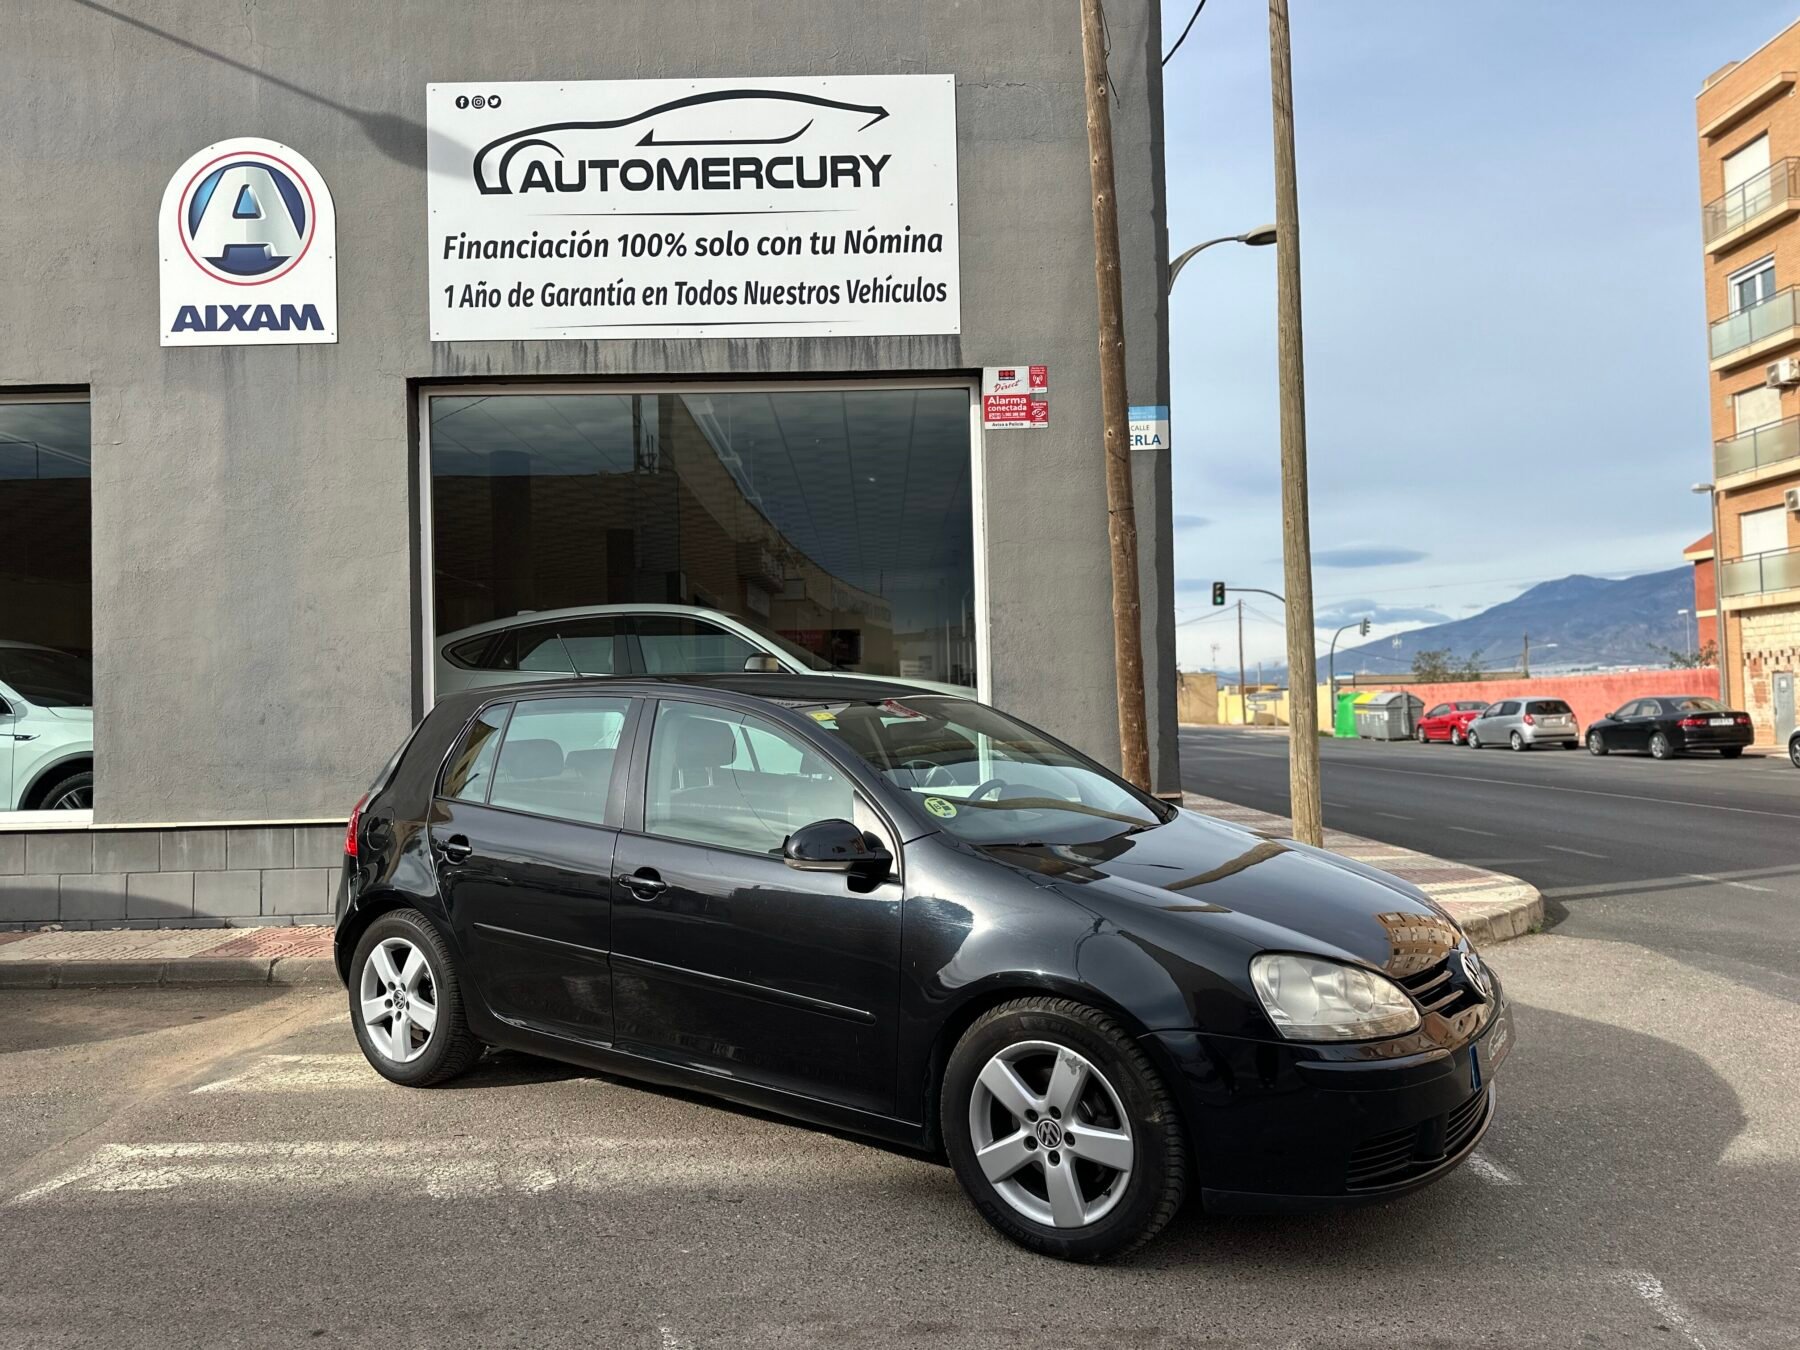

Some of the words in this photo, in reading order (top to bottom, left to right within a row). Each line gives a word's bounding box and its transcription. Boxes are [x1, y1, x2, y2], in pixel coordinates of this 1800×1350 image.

[520, 155, 892, 194] AUTOMERCURY
[443, 229, 609, 260] Financiación
[617, 232, 687, 258] 100%
[694, 229, 750, 257] solo
[756, 235, 802, 256] con
[809, 231, 836, 256] tu
[843, 225, 943, 255] Nómina
[444, 284, 454, 308] 1
[458, 280, 502, 308] Año
[507, 281, 535, 308] de
[540, 277, 636, 308] Garantía
[642, 286, 668, 306] en
[674, 279, 738, 306] Todos
[743, 280, 840, 306] Nuestros
[846, 274, 947, 304] Vehículos
[170, 303, 325, 332] AIXAM
[988, 396, 1027, 405] Alarma
[988, 404, 1027, 412] conectada
